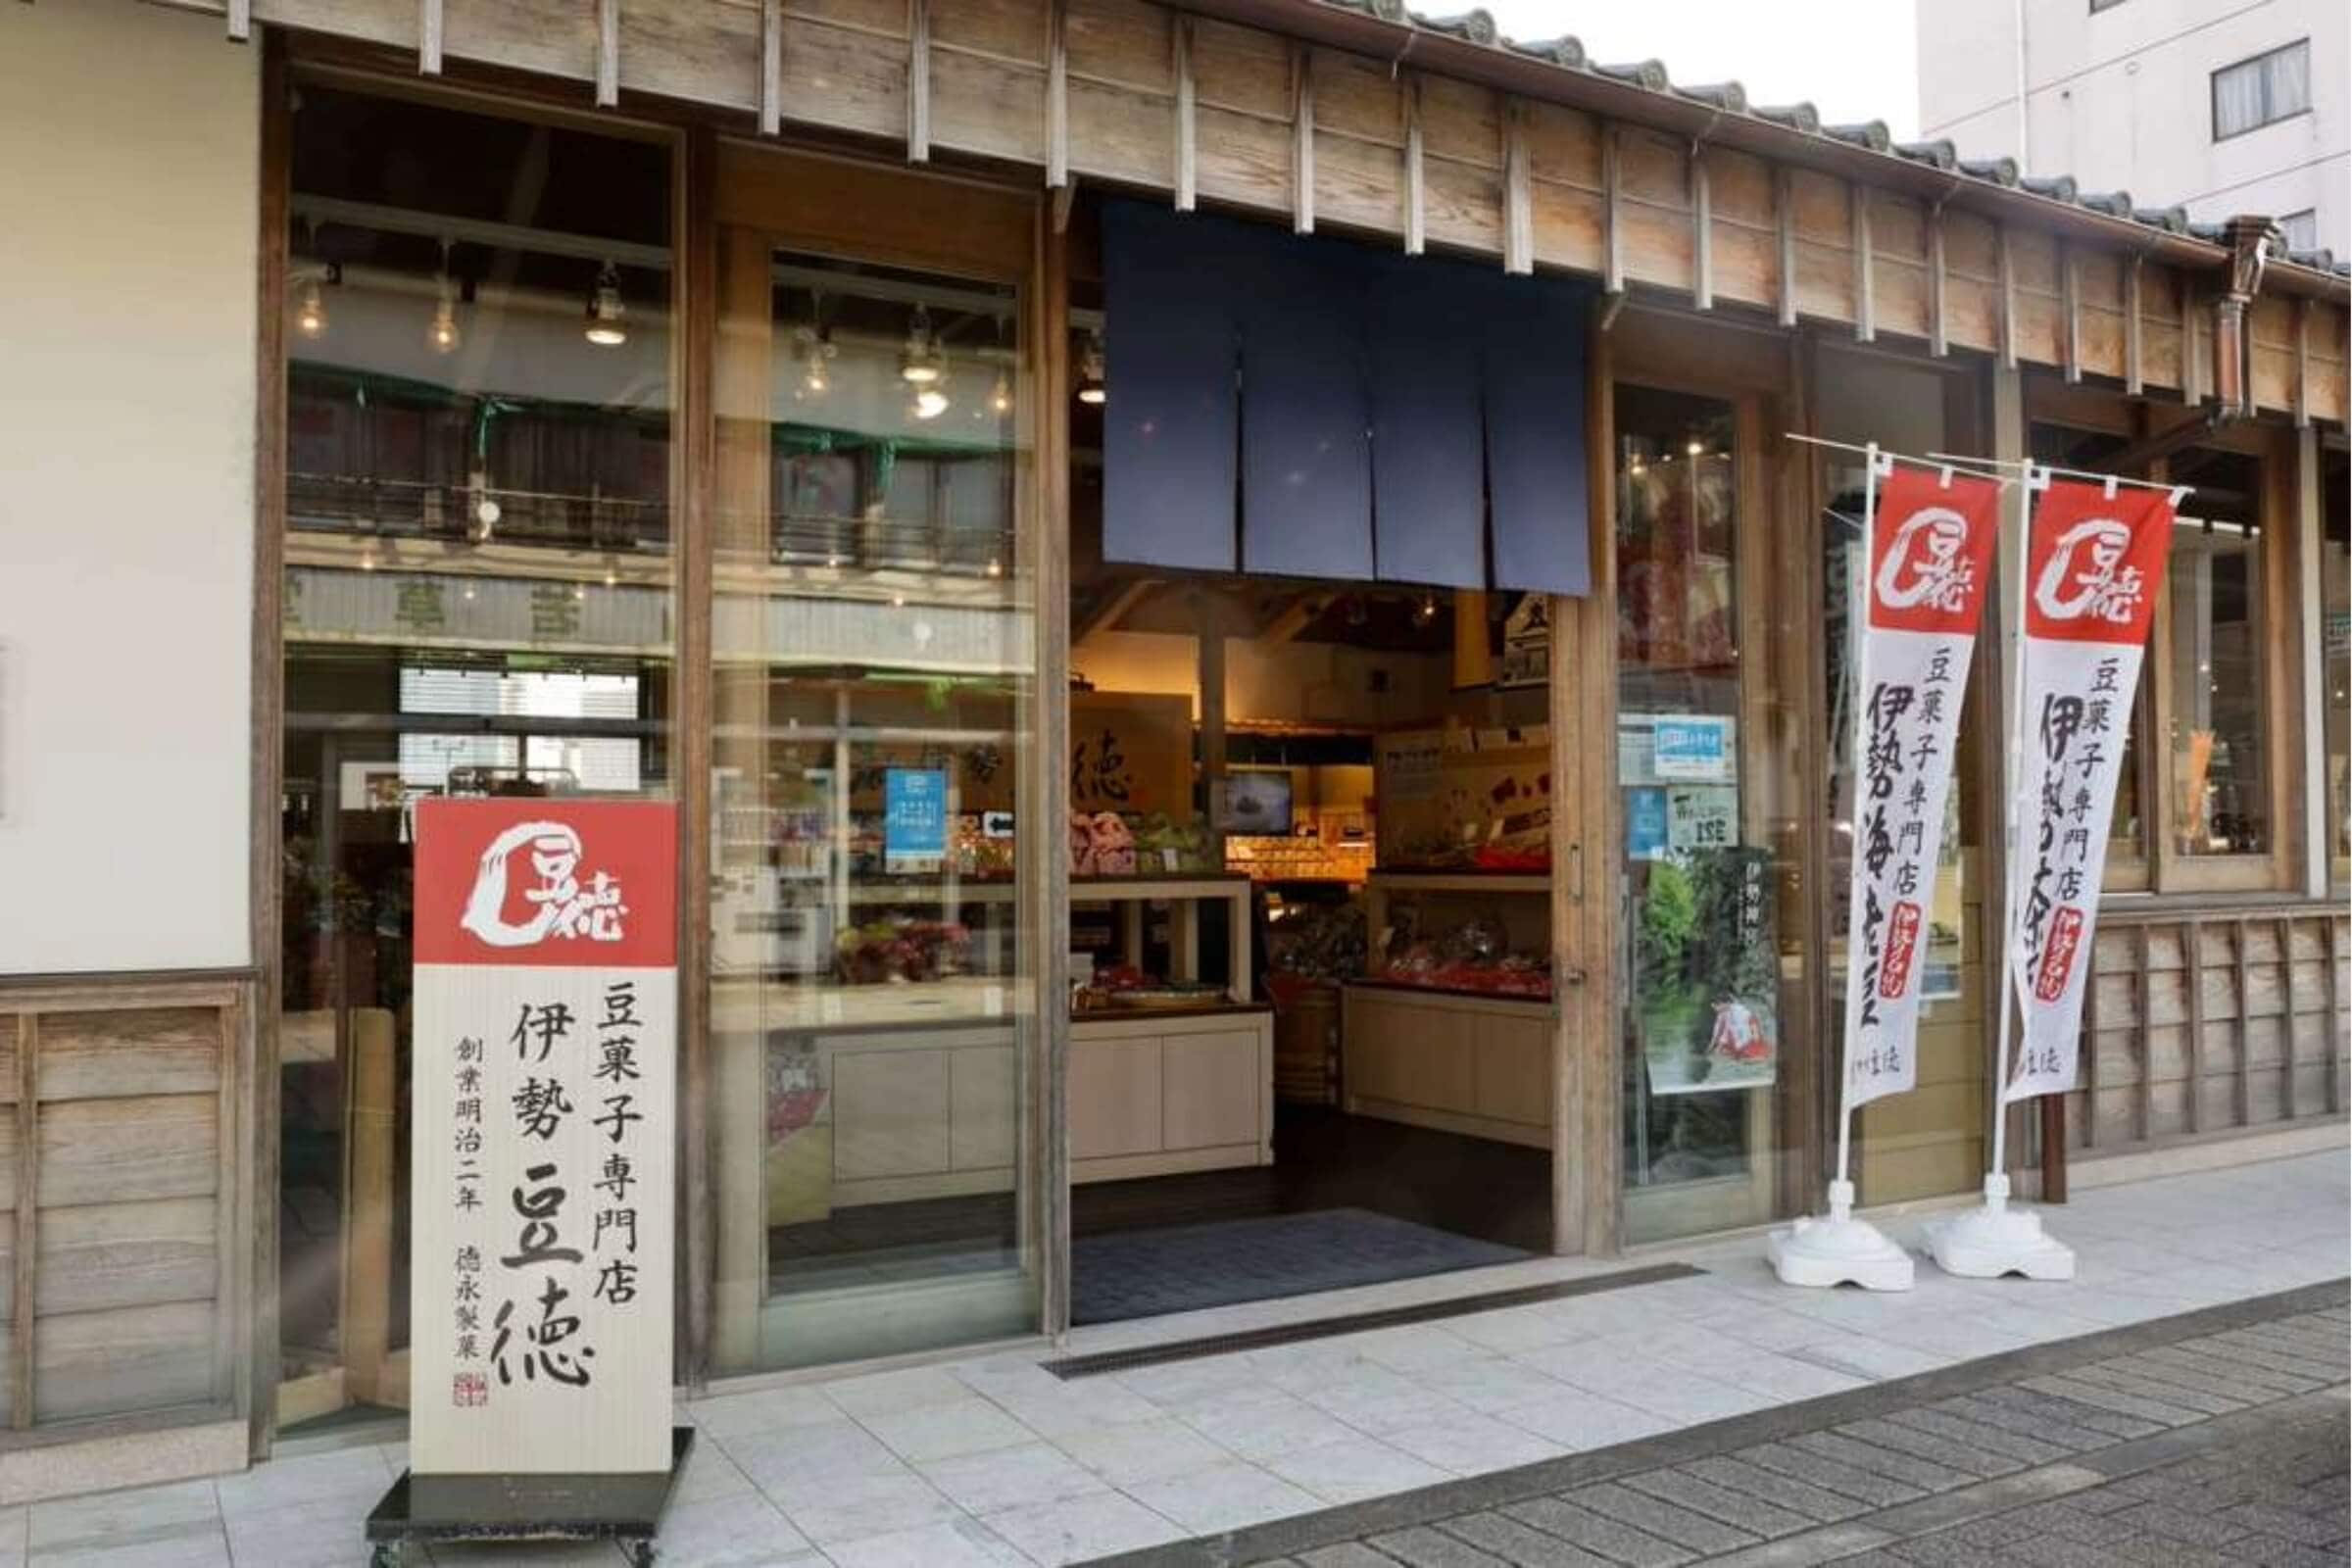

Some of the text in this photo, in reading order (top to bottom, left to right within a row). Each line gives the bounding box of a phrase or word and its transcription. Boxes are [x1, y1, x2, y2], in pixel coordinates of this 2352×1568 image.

[1892, 647, 1950, 896] 豆菓子専門店
[2056, 658, 2118, 901] 豆菓子専門店
[454, 1036, 483, 1212] 創業明治二年
[593, 982, 644, 1304] 豆菓子専門店
